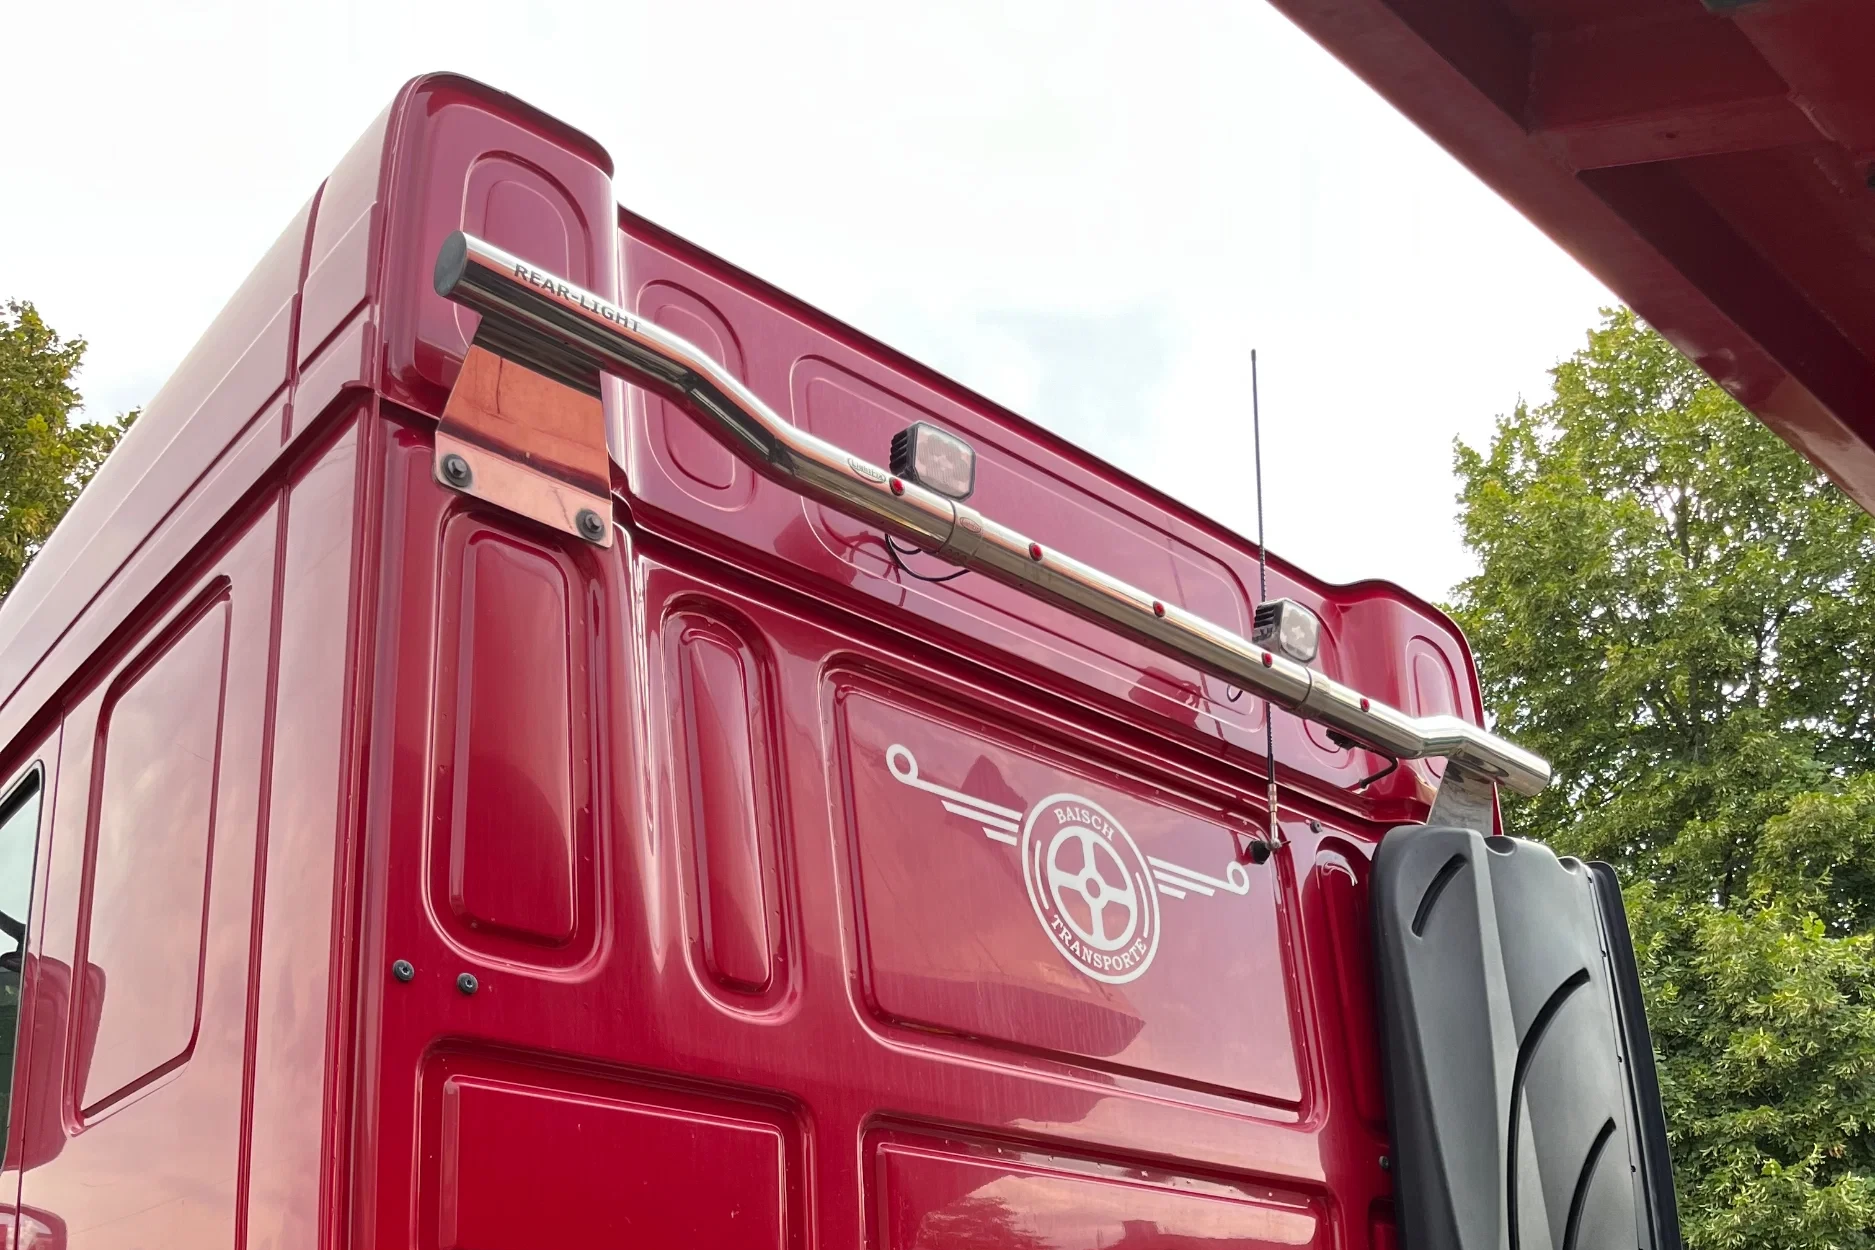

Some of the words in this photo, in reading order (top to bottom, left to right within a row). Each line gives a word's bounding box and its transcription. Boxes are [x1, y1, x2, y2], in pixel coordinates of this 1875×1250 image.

[513, 263, 642, 333] REAR-LIGHT
[1053, 806, 1115, 842] BAISCH
[1050, 914, 1148, 971] TRANSPORTE
